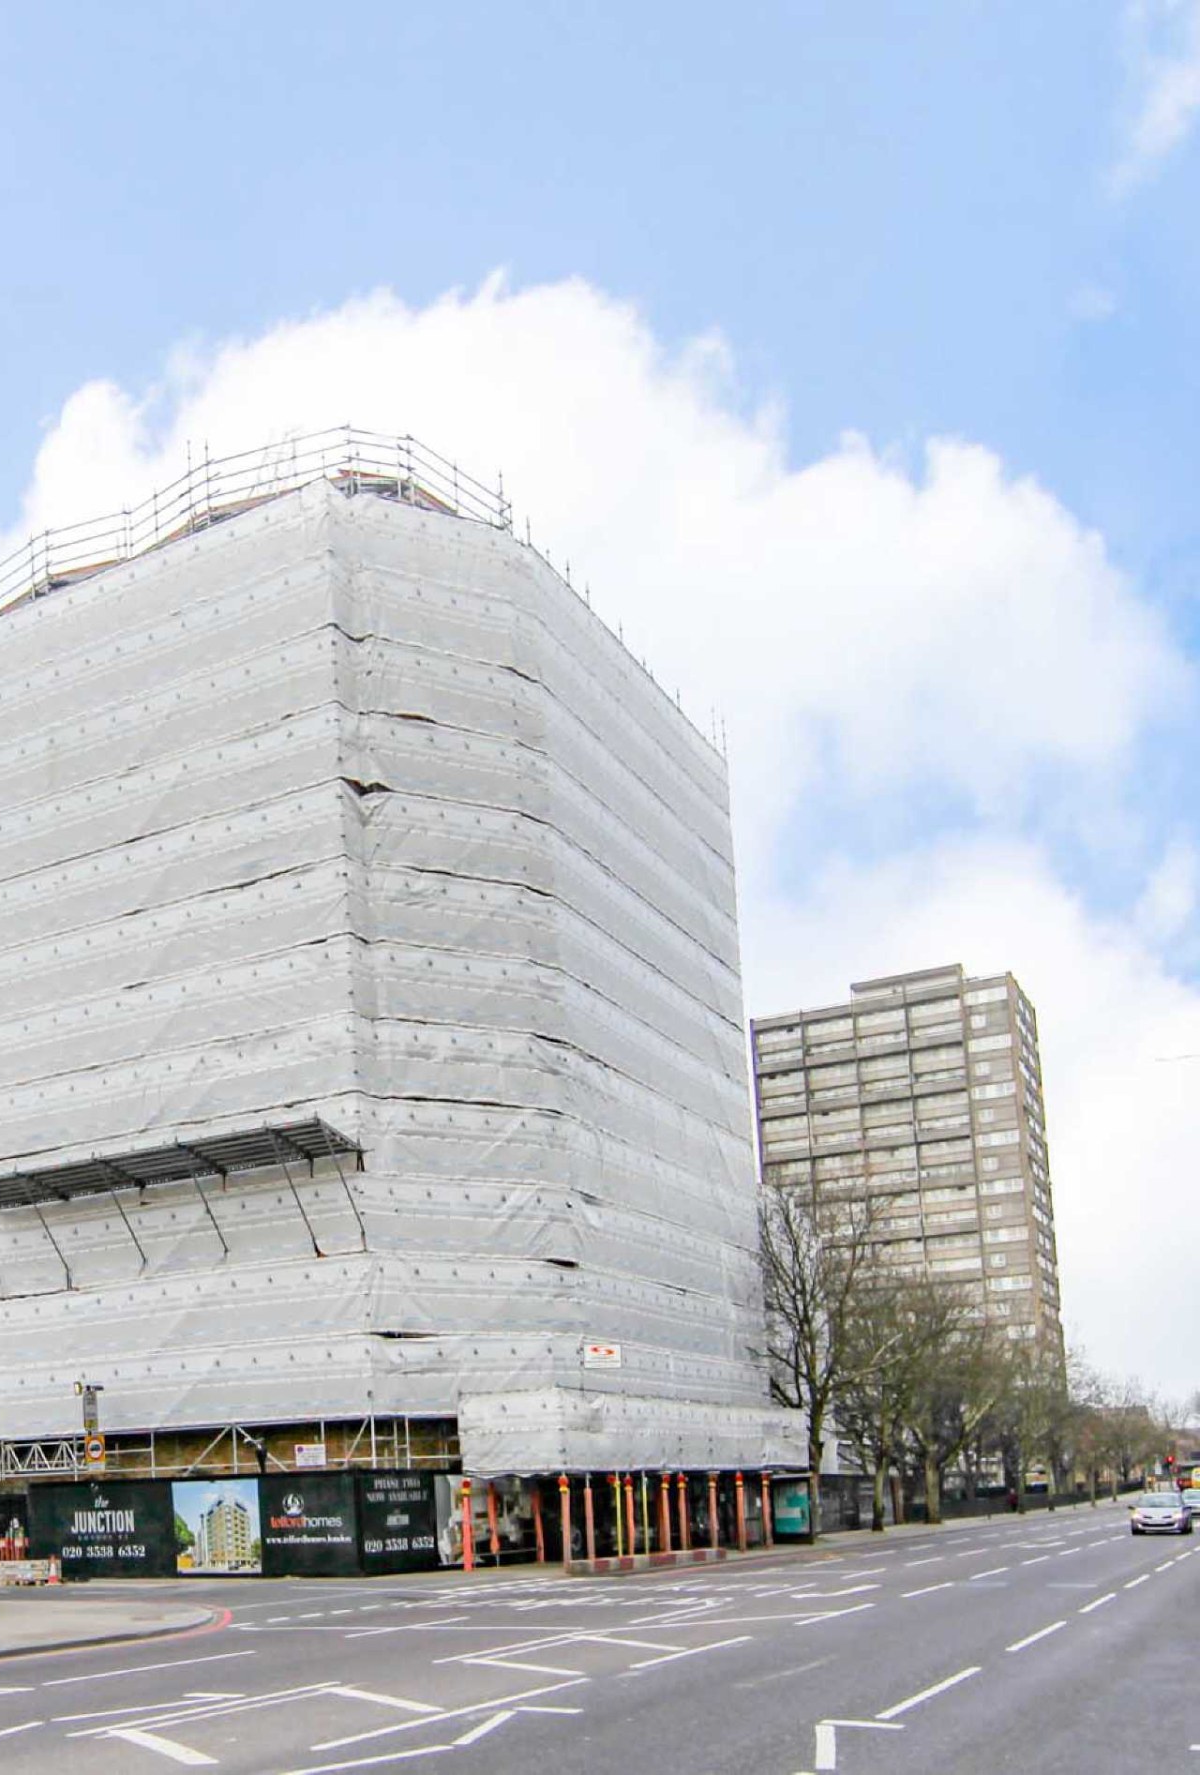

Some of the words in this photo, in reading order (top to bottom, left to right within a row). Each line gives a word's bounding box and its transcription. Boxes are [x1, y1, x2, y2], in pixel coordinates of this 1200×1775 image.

[71, 1510, 135, 1533] JUNCTION
[62, 1546, 83, 1559] 020
[86, 1546, 114, 1558] 3538
[118, 1545, 146, 1557] 6352
[364, 1540, 383, 1553] 020
